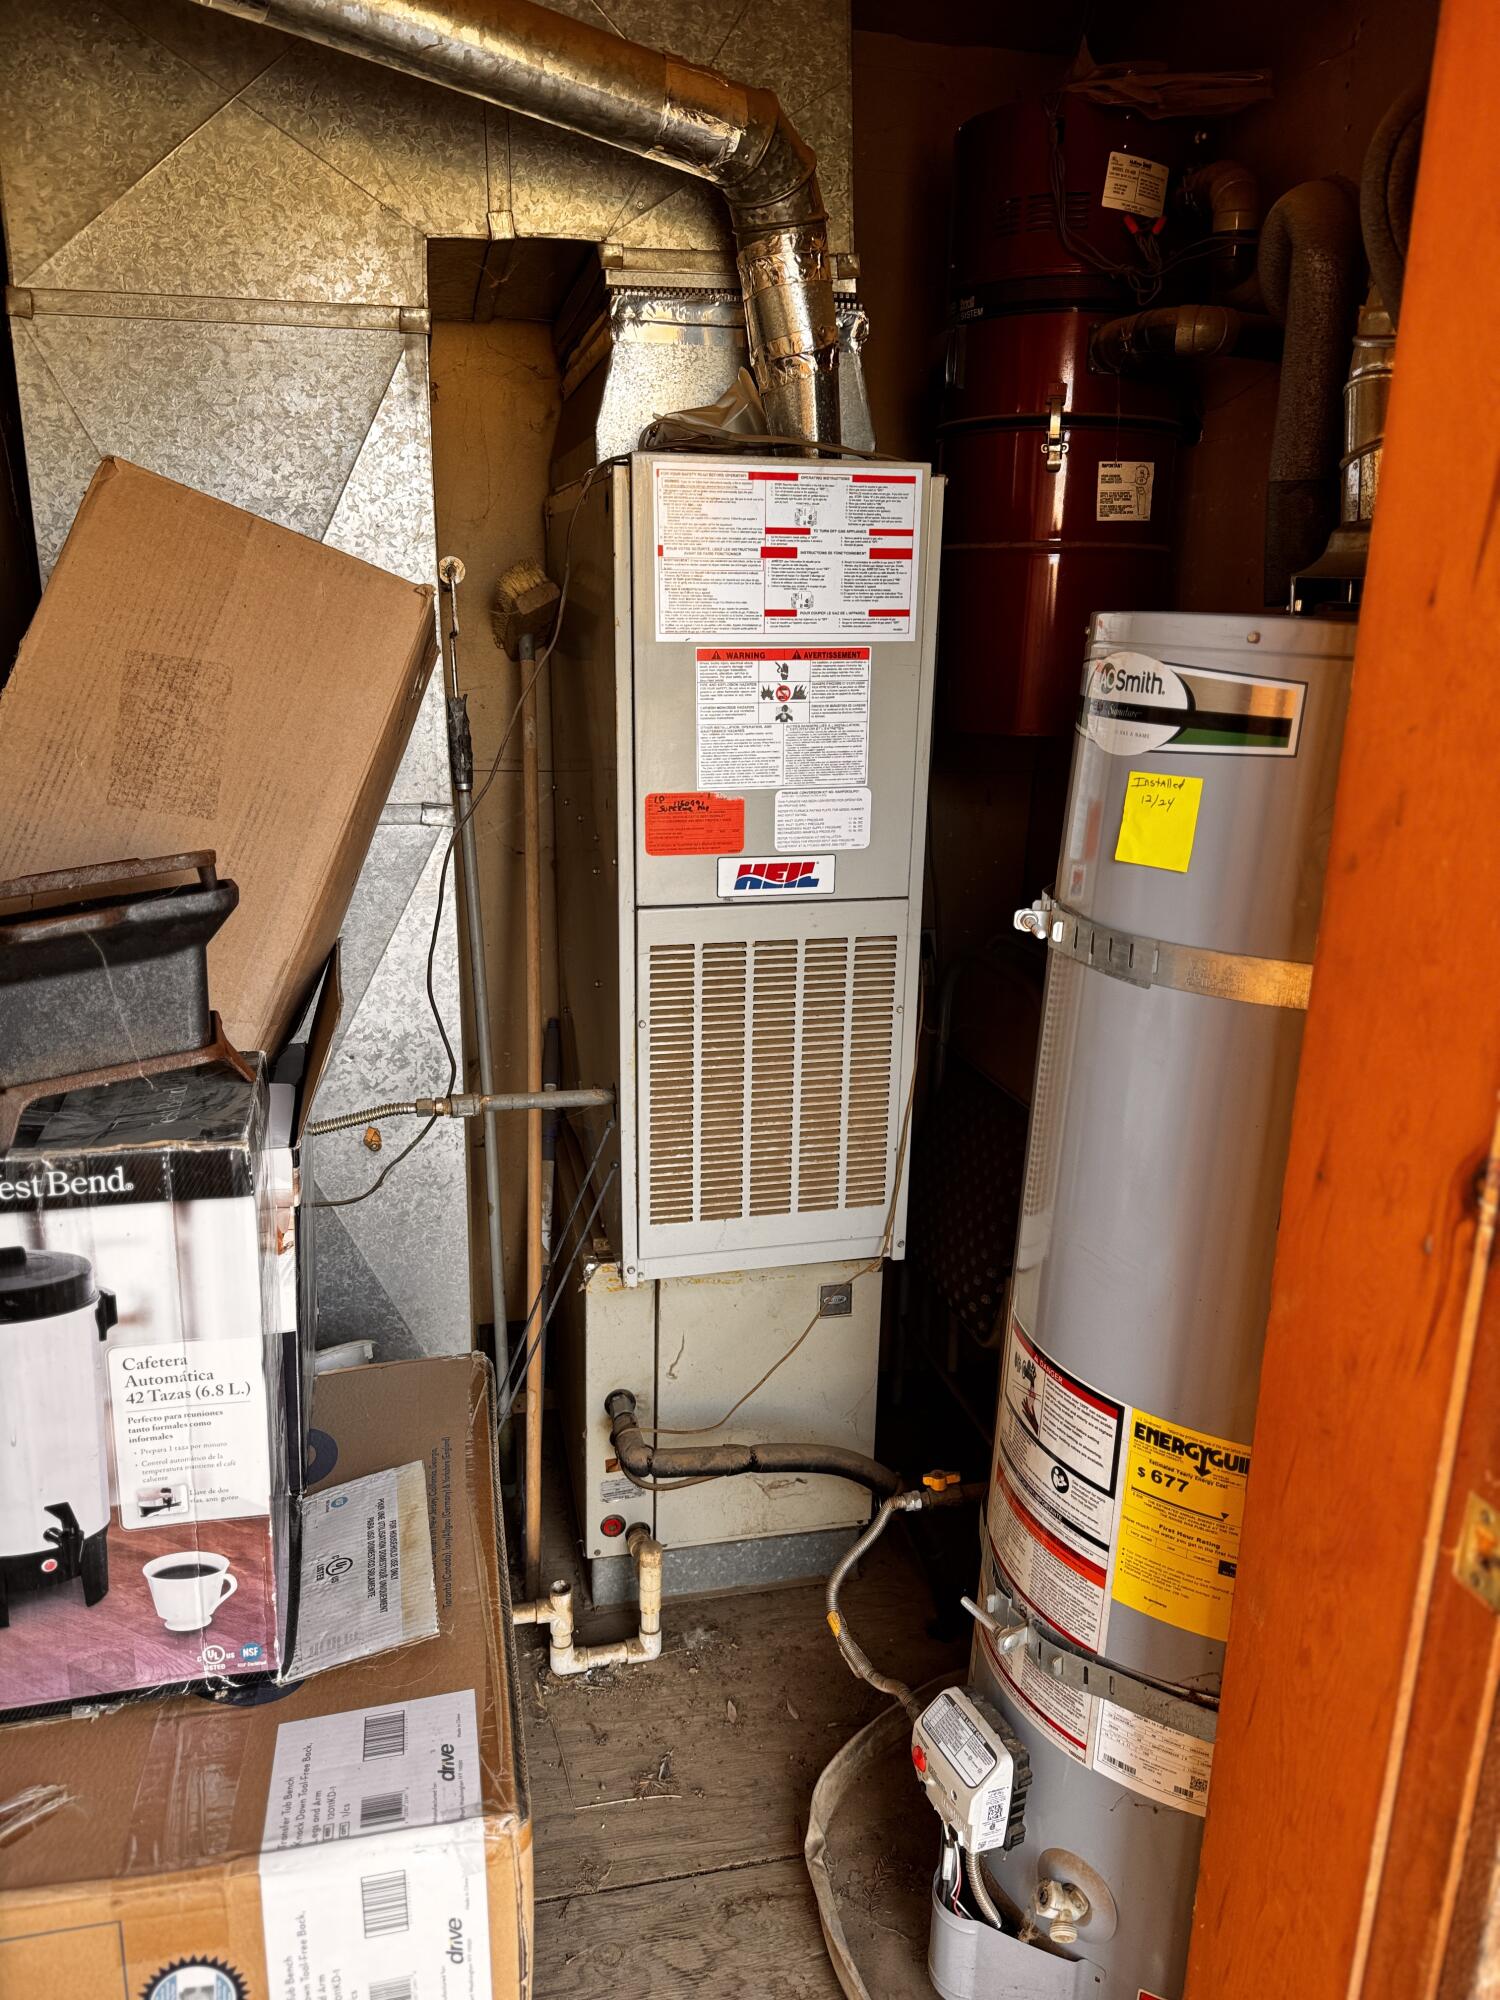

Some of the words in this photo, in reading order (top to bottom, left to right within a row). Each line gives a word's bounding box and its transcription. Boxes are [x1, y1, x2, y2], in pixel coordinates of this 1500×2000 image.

[1131, 777, 1186, 790] Installed
[1142, 794, 1175, 812] 12/24
[734, 862, 819, 890] HEIL
[0, 1175, 44, 1200] est
[122, 1356, 188, 1370] Cafetera
[1040, 1360, 1063, 1385] DANGER
[124, 1370, 214, 1388] Automática
[126, 1391, 144, 1404] 42
[147, 1388, 191, 1402] Tazas
[195, 1383, 224, 1400] (6.8
[228, 1382, 251, 1396] L.)
[128, 1415, 162, 1424] Perfecto
[164, 1414, 182, 1423] para
[184, 1410, 223, 1419] reuniones
[128, 1426, 150, 1434] tanto
[152, 1422, 188, 1431] formales
[129, 1433, 173, 1444] informales
[1134, 1421, 1250, 1476] ENERGYGUI
[141, 1448, 166, 1456] Prepara
[141, 1458, 168, 1467] Control
[142, 1466, 183, 1476] temperatura
[143, 1475, 168, 1483] caliente
[1138, 1466, 1146, 1478] $
[1151, 1469, 1189, 1493] 677
[1149, 1458, 1175, 1472] Estimated
[1176, 1468, 1194, 1480] Yearly
[390, 1530, 398, 1558] HOUSEHOLD
[1130, 1530, 1140, 1538] very
[1136, 1520, 1149, 1530] much
[1161, 1531, 1175, 1540] water
[1176, 1537, 1186, 1545] you
[1188, 1540, 1197, 1548] get
[1214, 1549, 1226, 1557] first
[1159, 1524, 1175, 1533] First
[1177, 1530, 1194, 1541] Hour
[1196, 1537, 1221, 1549] Rating
[368, 1569, 376, 1598] SOLAMENTE
[442, 1583, 452, 1608] Toronto
[207, 1650, 219, 1660] UL
[242, 1647, 259, 1658] NSF
[954, 1704, 966, 1720] STATUS
[964, 1719, 976, 1734] LIGHT
[437, 1744, 455, 1782] drive
[297, 1798, 305, 1821] Down
[304, 1742, 313, 1765] Back,
[282, 1799, 292, 1818] Tub
[287, 1776, 295, 1798] Bench
[314, 1791, 322, 1805] Arm
[445, 1918, 464, 1964] drive
[284, 1956, 294, 1979] Bench
[318, 1974, 326, 1993] Arm
